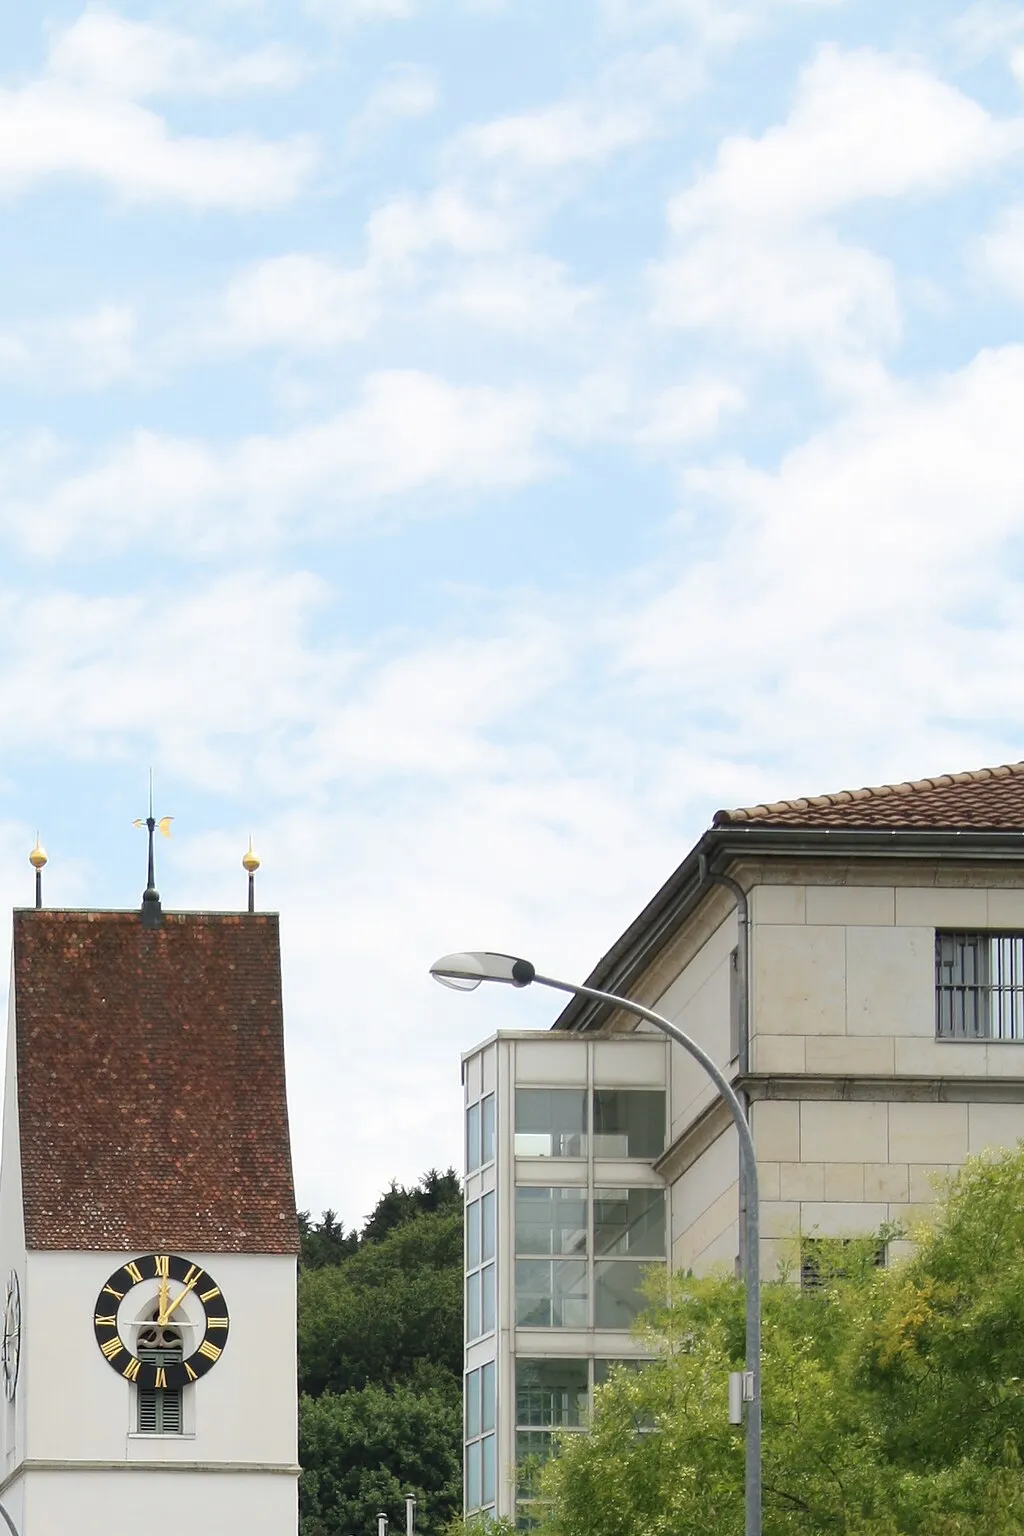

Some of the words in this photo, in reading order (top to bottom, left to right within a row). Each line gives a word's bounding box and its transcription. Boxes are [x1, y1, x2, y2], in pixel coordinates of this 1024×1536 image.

[124, 1262, 144, 1284] XI
[103, 1284, 124, 1301] X
[199, 1287, 220, 1302] II
[207, 1316, 228, 1329] III
[184, 1362, 198, 1381] V
